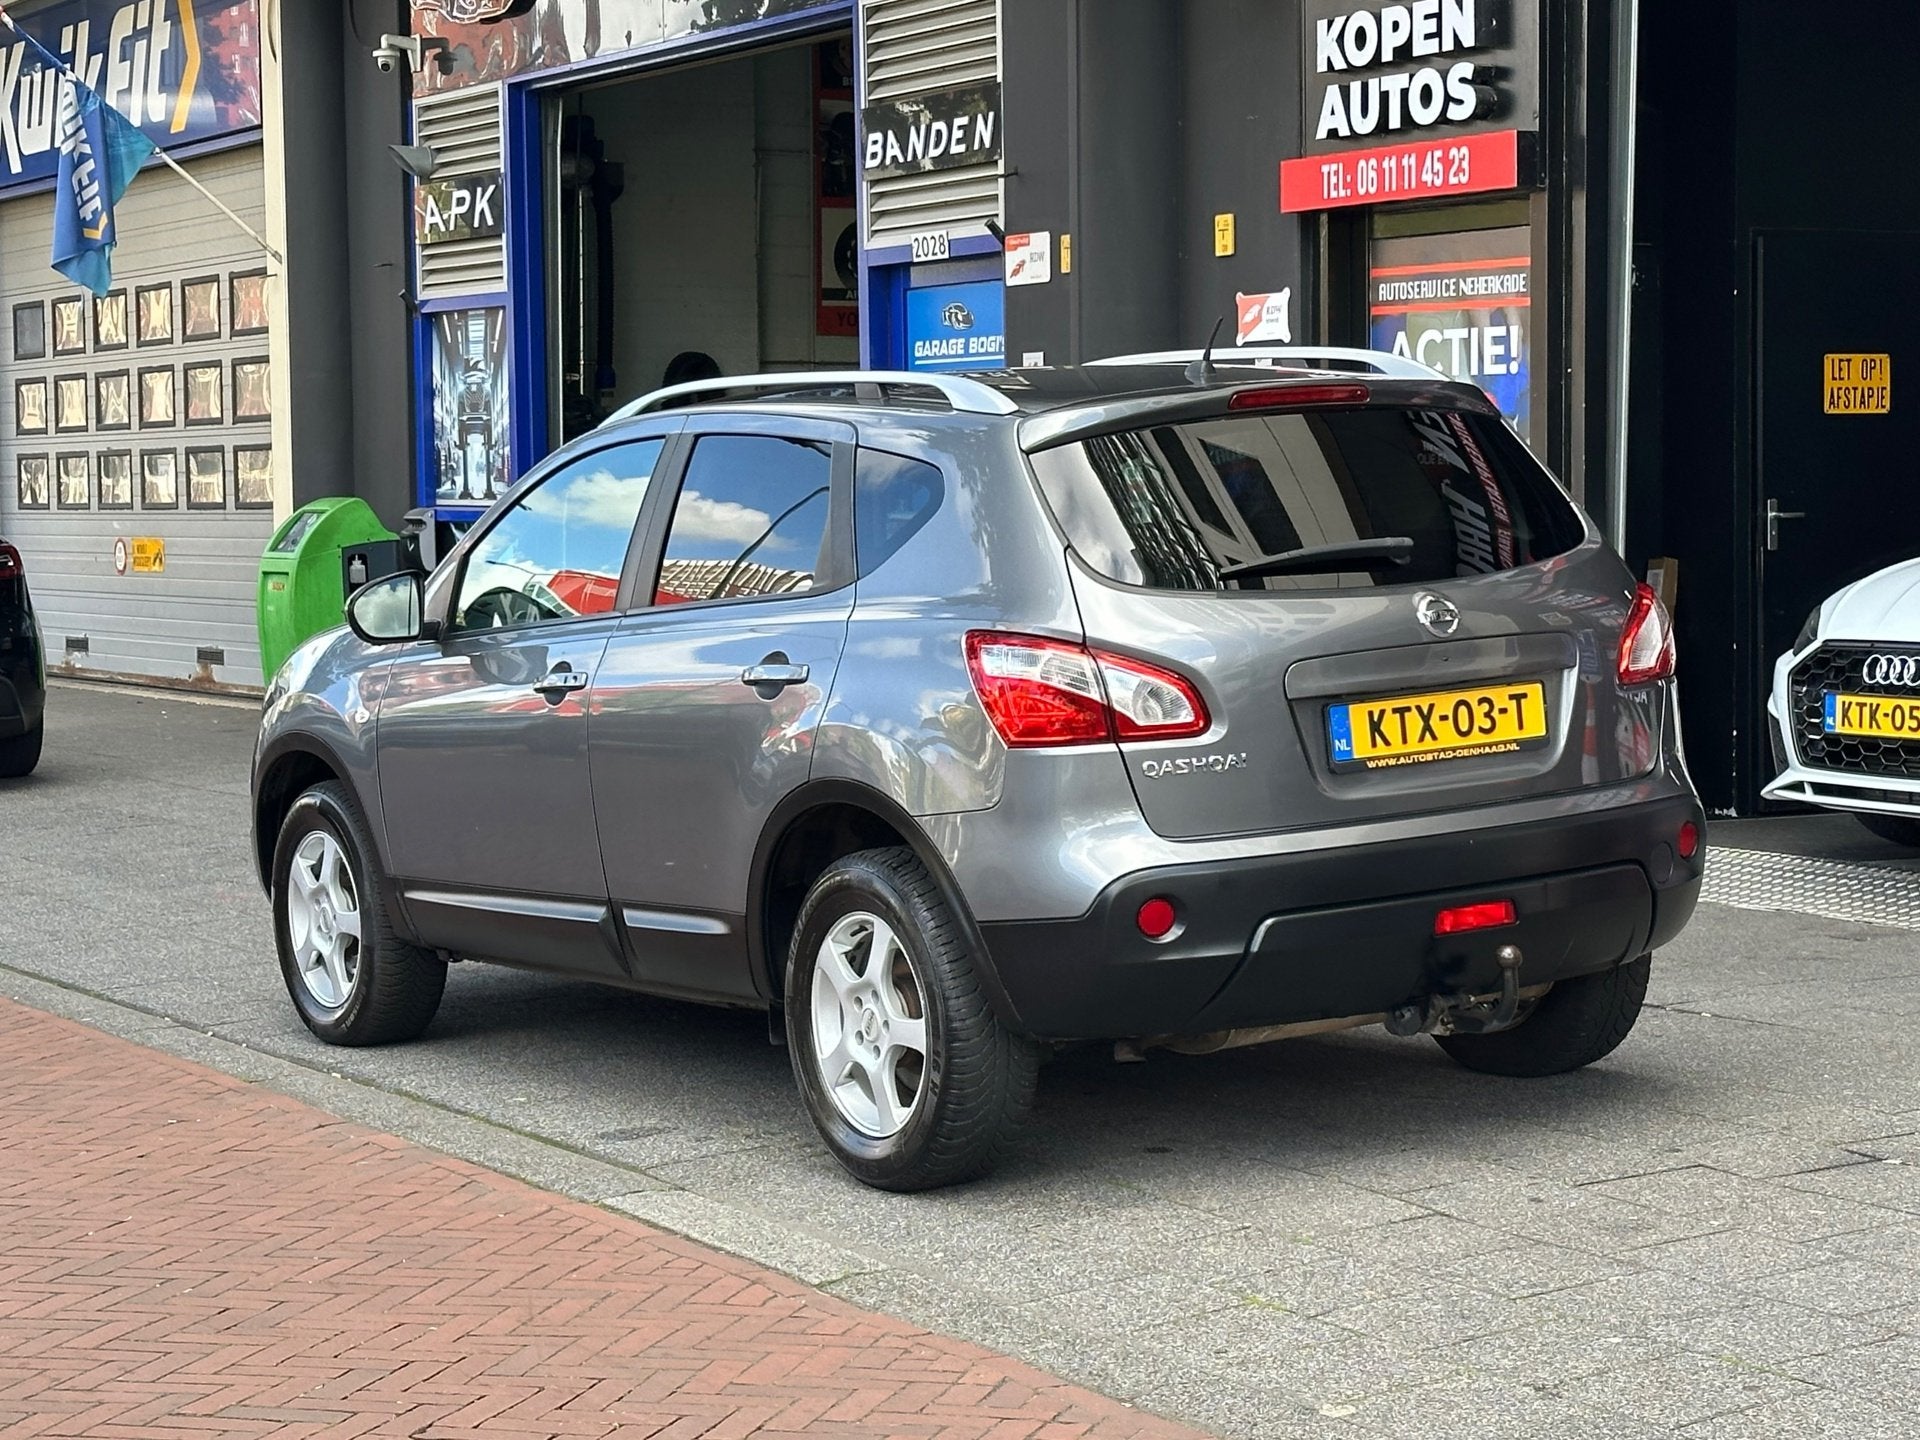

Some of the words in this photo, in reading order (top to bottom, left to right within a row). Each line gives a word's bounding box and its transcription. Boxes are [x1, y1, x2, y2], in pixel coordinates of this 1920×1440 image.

[1316, 0, 1475, 73] KOPEN
[1315, 61, 1477, 140] AUTOS
[865, 111, 995, 169] BANDEN
[1320, 162, 1352, 200] TEL:
[1357, 157, 1378, 196] 06
[1382, 154, 1397, 193] 11
[1402, 151, 1417, 190] 11
[1421, 148, 1444, 188] 45
[1448, 145, 1470, 186] 23
[424, 184, 497, 235] APK
[913, 234, 947, 259] 2028
[1378, 278, 1457, 302] AUTOSERVICE
[1459, 273, 1528, 297] NEHERKADE
[914, 338, 966, 358] GARAGE
[1391, 325, 1520, 376] ACTIE!
[1830, 357, 1853, 382] LET
[1861, 357, 1883, 382] OP!
[1828, 386, 1887, 410] AFSTAPJE
[1367, 692, 1529, 750] KTX-03-T
[1841, 700, 1920, 733] KTK-05
[1334, 738, 1351, 752] NL
[1366, 742, 1521, 769] WWW.AUTOSTAD-DENHAAG.NL
[1142, 752, 1247, 779] QASHQAI
